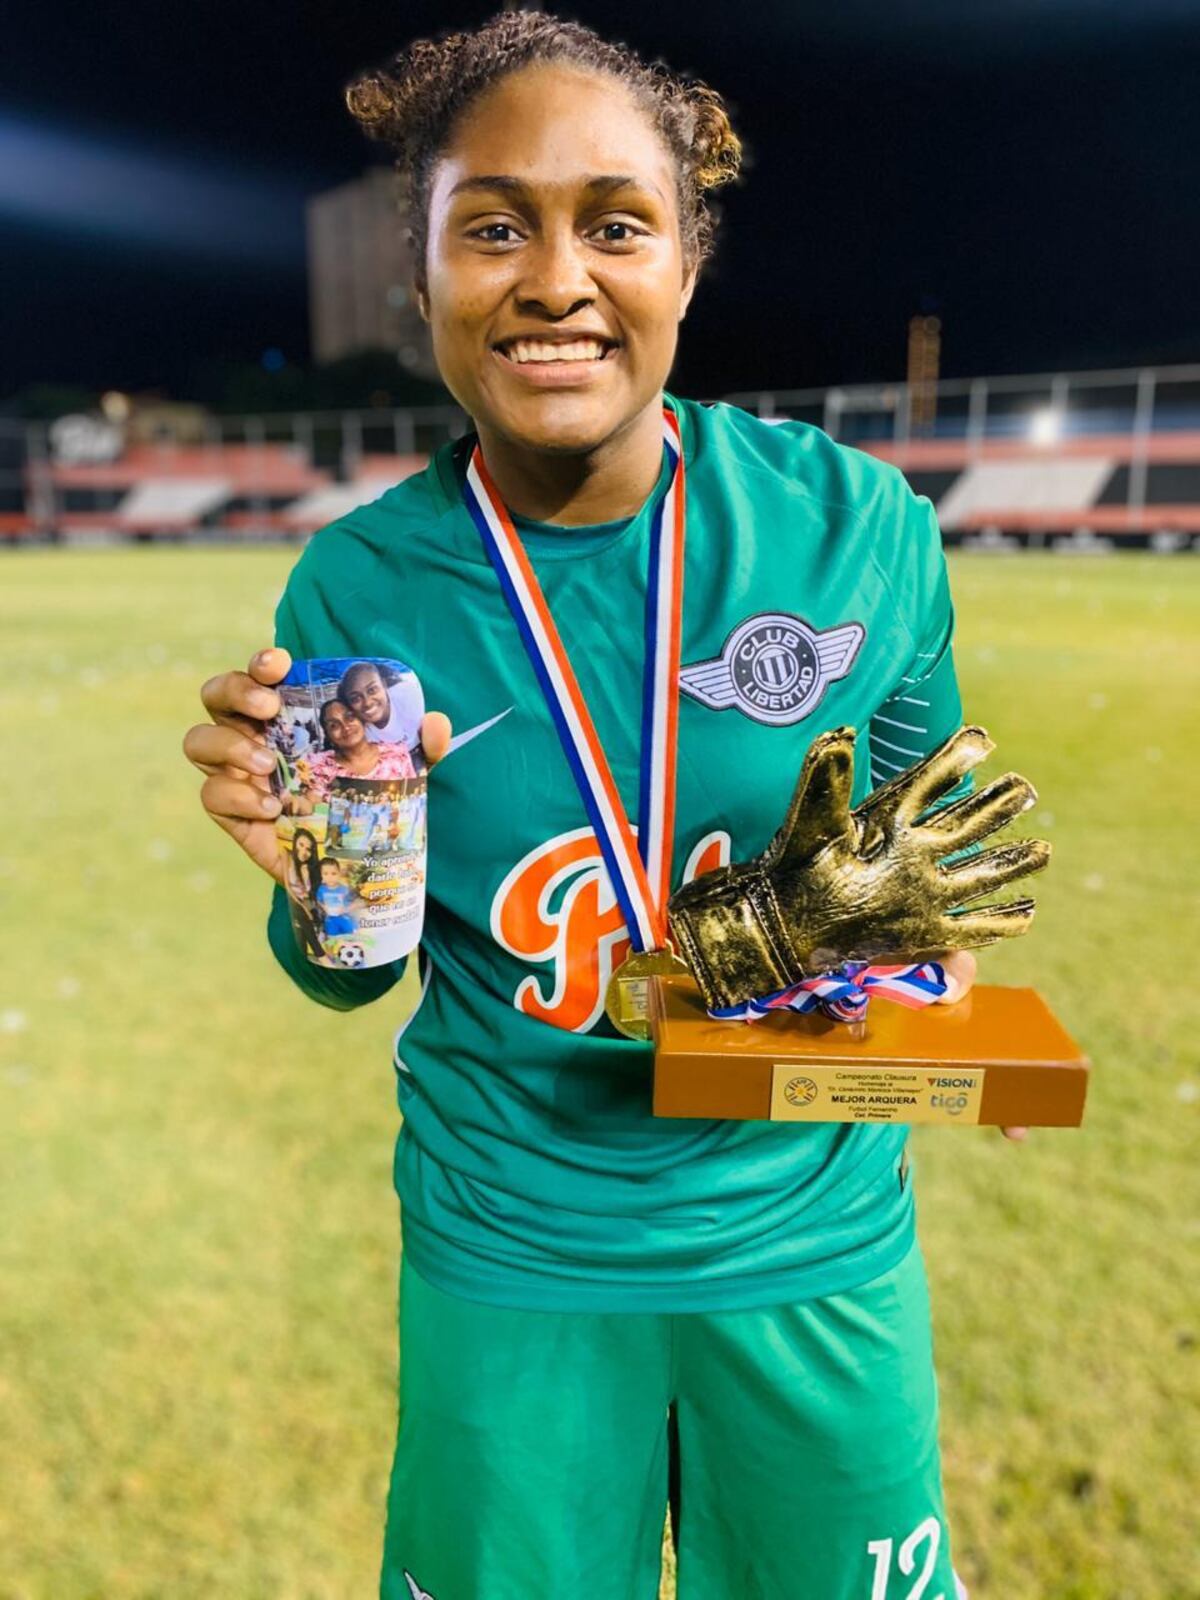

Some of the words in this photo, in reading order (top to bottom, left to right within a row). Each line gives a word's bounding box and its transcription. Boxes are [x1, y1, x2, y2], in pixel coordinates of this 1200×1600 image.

[740, 629, 800, 661] CLUB
[742, 666, 814, 709] LIBERTAD
[836, 1073, 882, 1082] Campeonato
[831, 1095, 866, 1104] MEJOR
[868, 1096, 918, 1105] ARQUERA
[868, 1516, 945, 1600] 12
